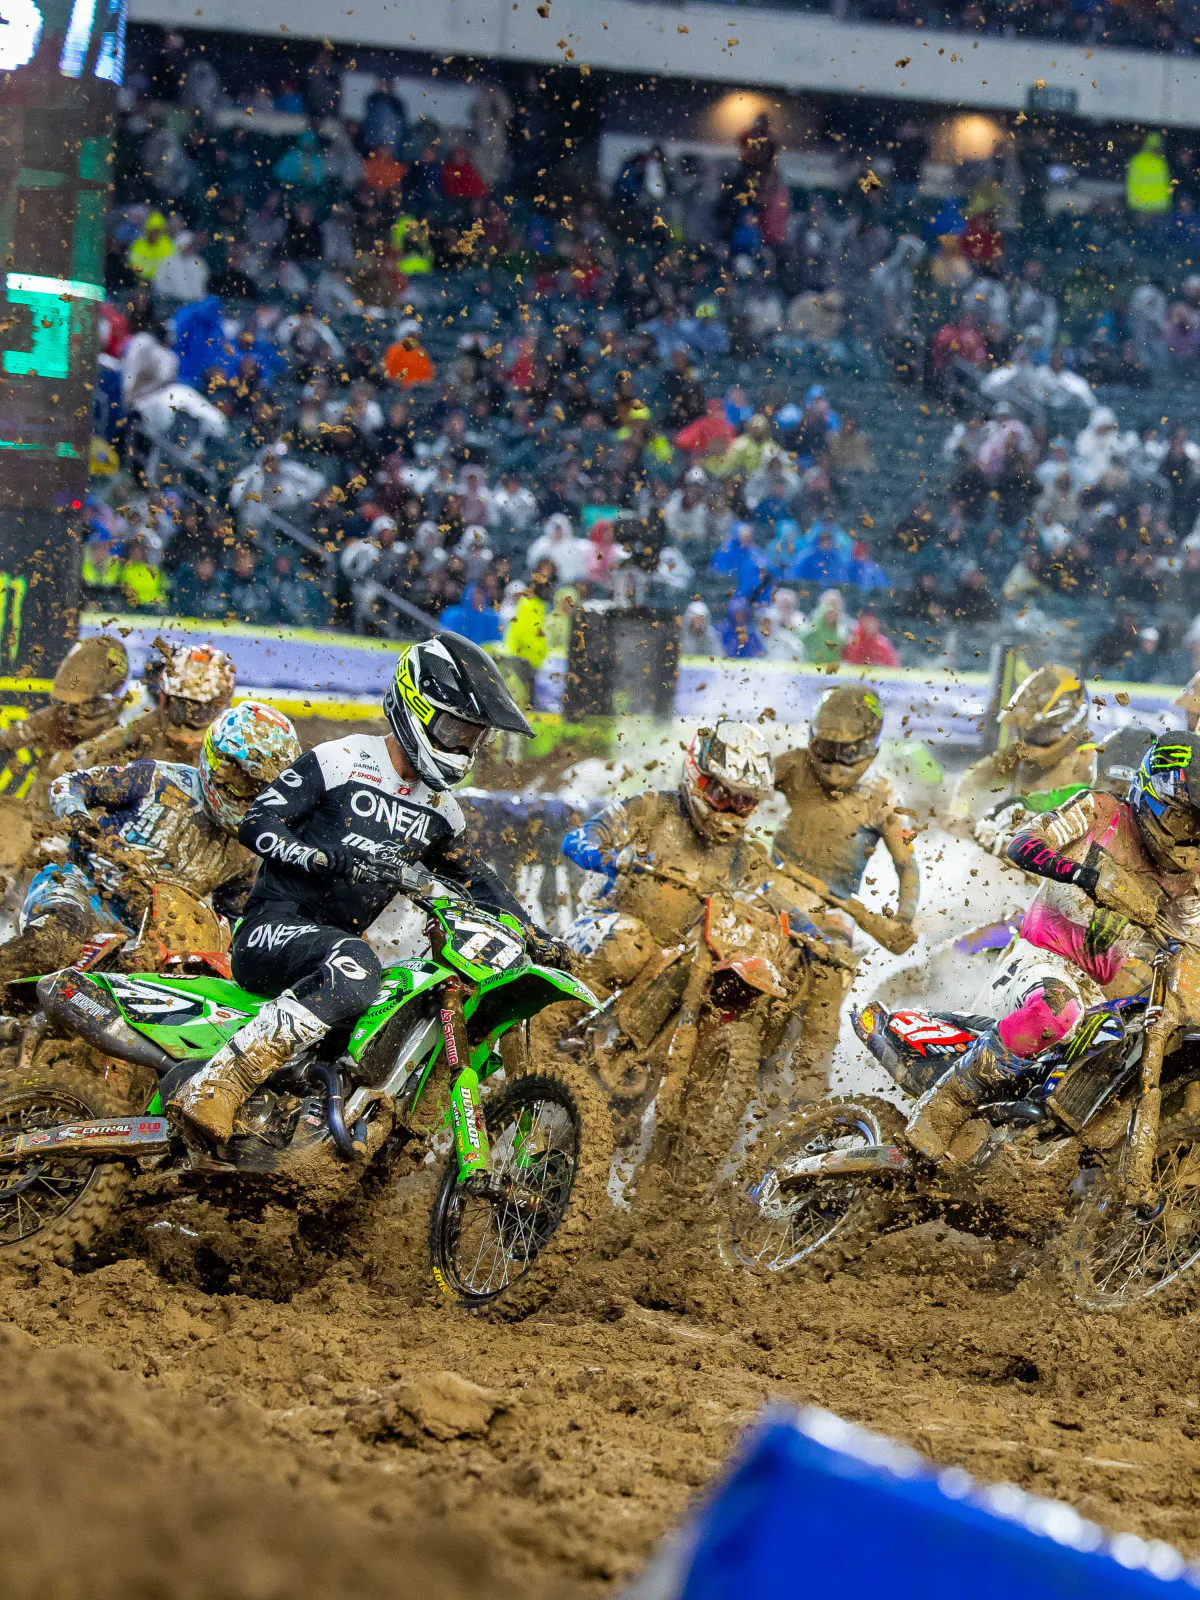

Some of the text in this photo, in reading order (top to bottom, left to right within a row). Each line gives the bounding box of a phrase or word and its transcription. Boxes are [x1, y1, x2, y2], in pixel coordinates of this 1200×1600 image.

[353, 763, 381, 772] GARMIN
[356, 772, 382, 784] SHOWA
[443, 1023, 459, 1066] SHOWA
[459, 1086, 481, 1149] DUNLOP
